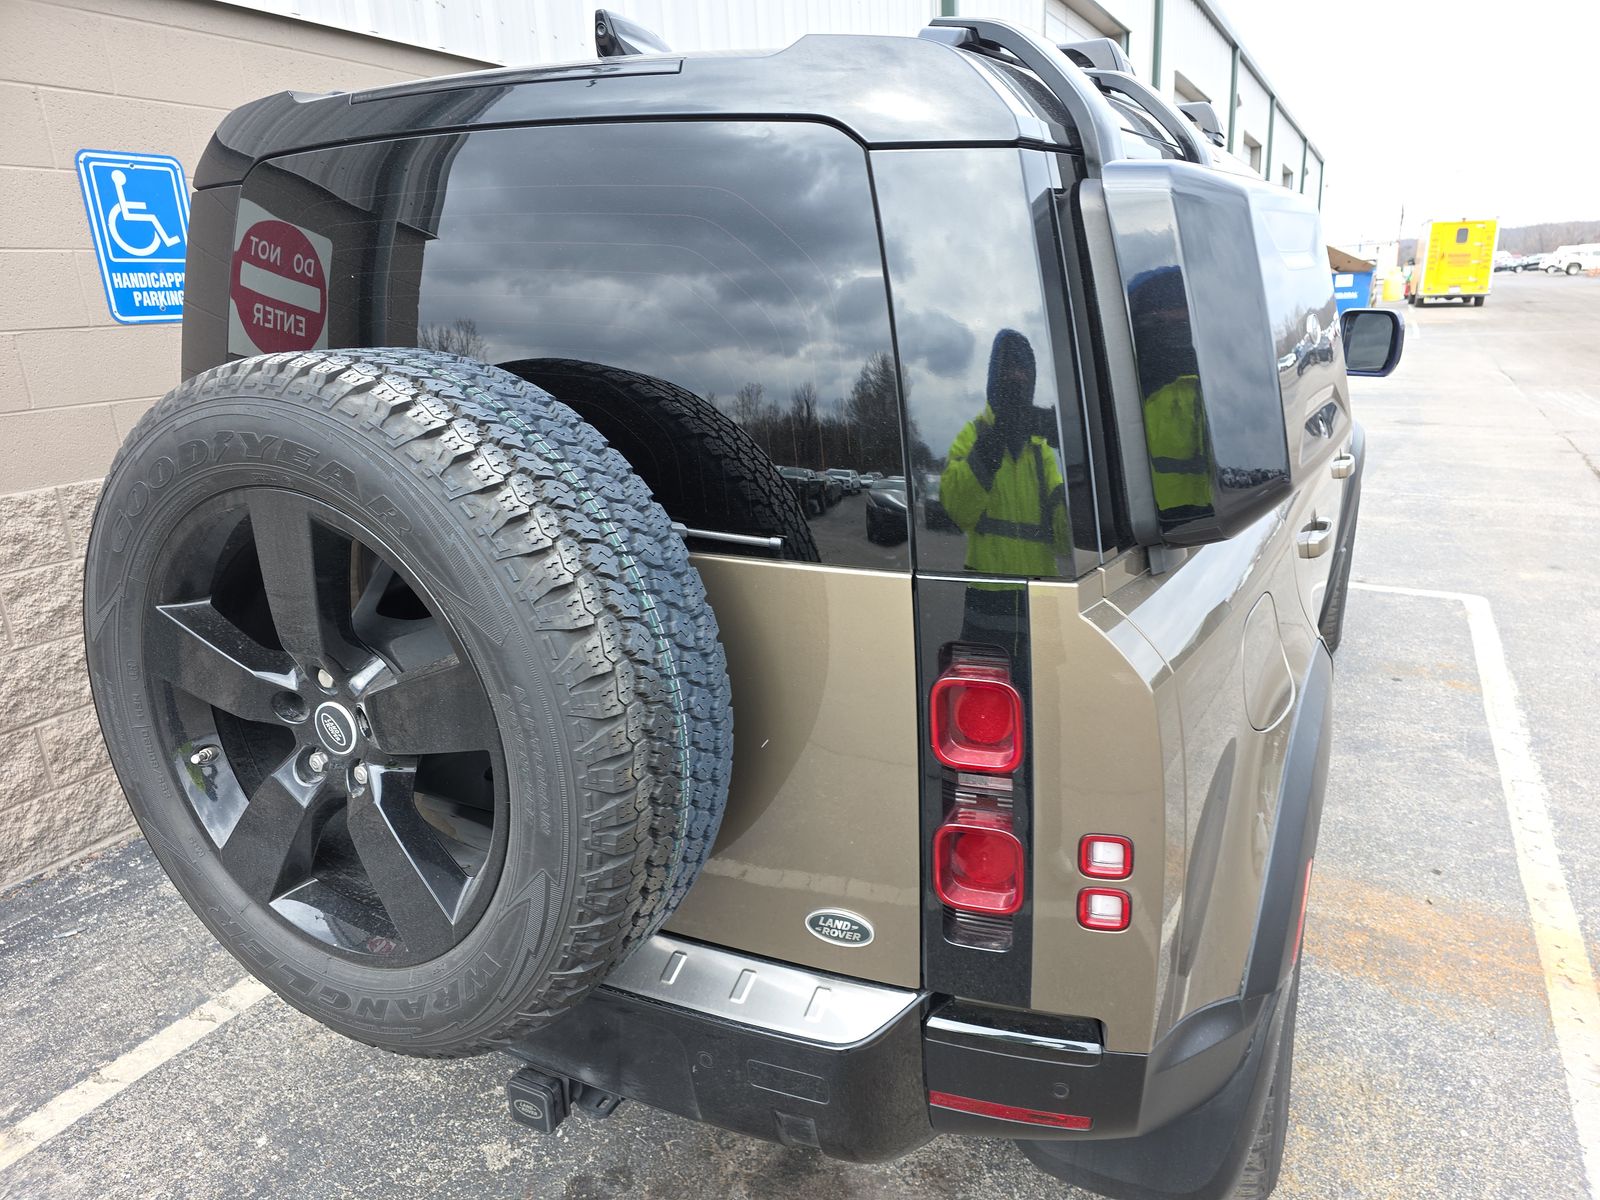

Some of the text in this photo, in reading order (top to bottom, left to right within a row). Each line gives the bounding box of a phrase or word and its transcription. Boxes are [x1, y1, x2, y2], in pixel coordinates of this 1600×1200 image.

[112, 272, 185, 289] HANDICAPP
[111, 430, 413, 553] GOODYEAR
[818, 916, 851, 931] LAND
[821, 926, 862, 941] ROVER
[207, 905, 502, 1022] WRANGLER
